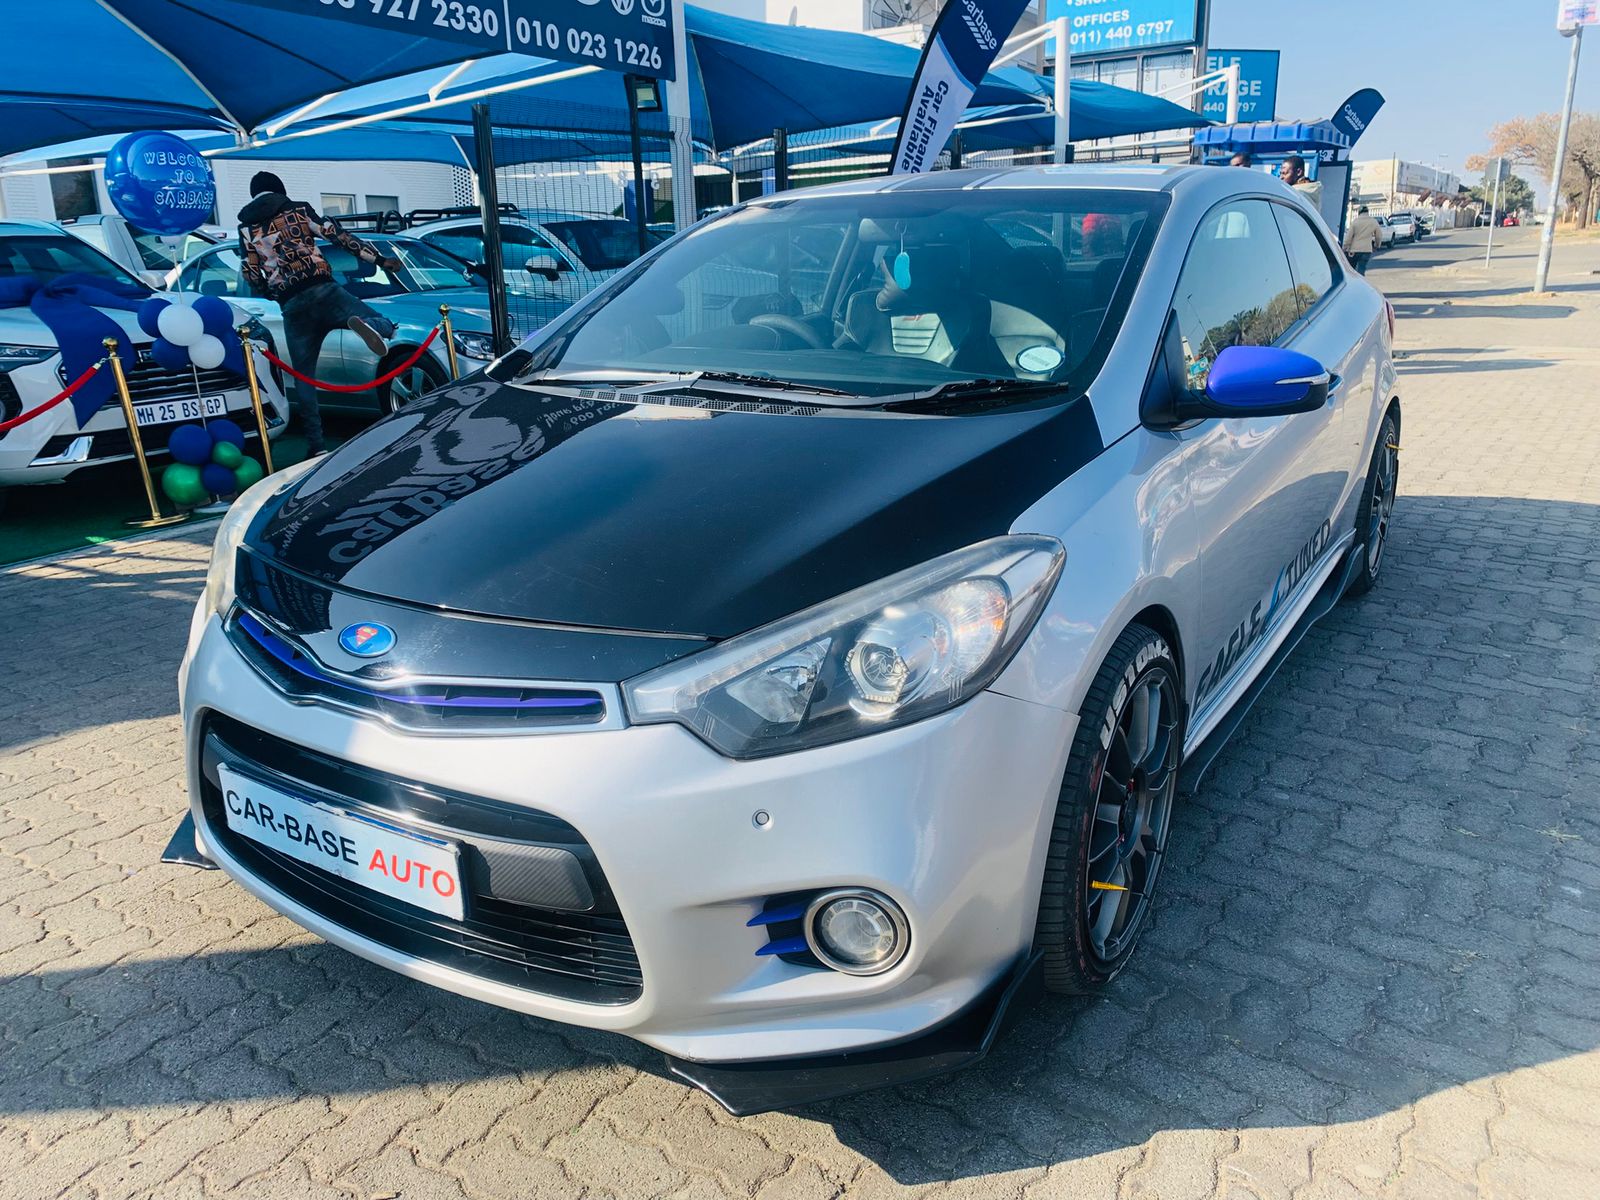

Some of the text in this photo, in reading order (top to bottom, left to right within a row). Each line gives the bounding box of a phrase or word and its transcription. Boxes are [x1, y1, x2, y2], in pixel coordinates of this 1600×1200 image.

[431, 0, 499, 37] 2330
[962, 0, 998, 50] arbase
[1073, 10, 1130, 28] OFFICES
[1105, 26, 1132, 40] 440
[1136, 20, 1174, 36] 6797
[516, 17, 662, 70] 010 023 1226
[1203, 101, 1225, 112] 440
[901, 84, 934, 171] Available
[911, 80, 949, 174] Car Financ
[175, 169, 194, 184] TO
[136, 398, 221, 424] MH 25 BS GP
[226, 789, 456, 897] CAR-BASE AUTO
